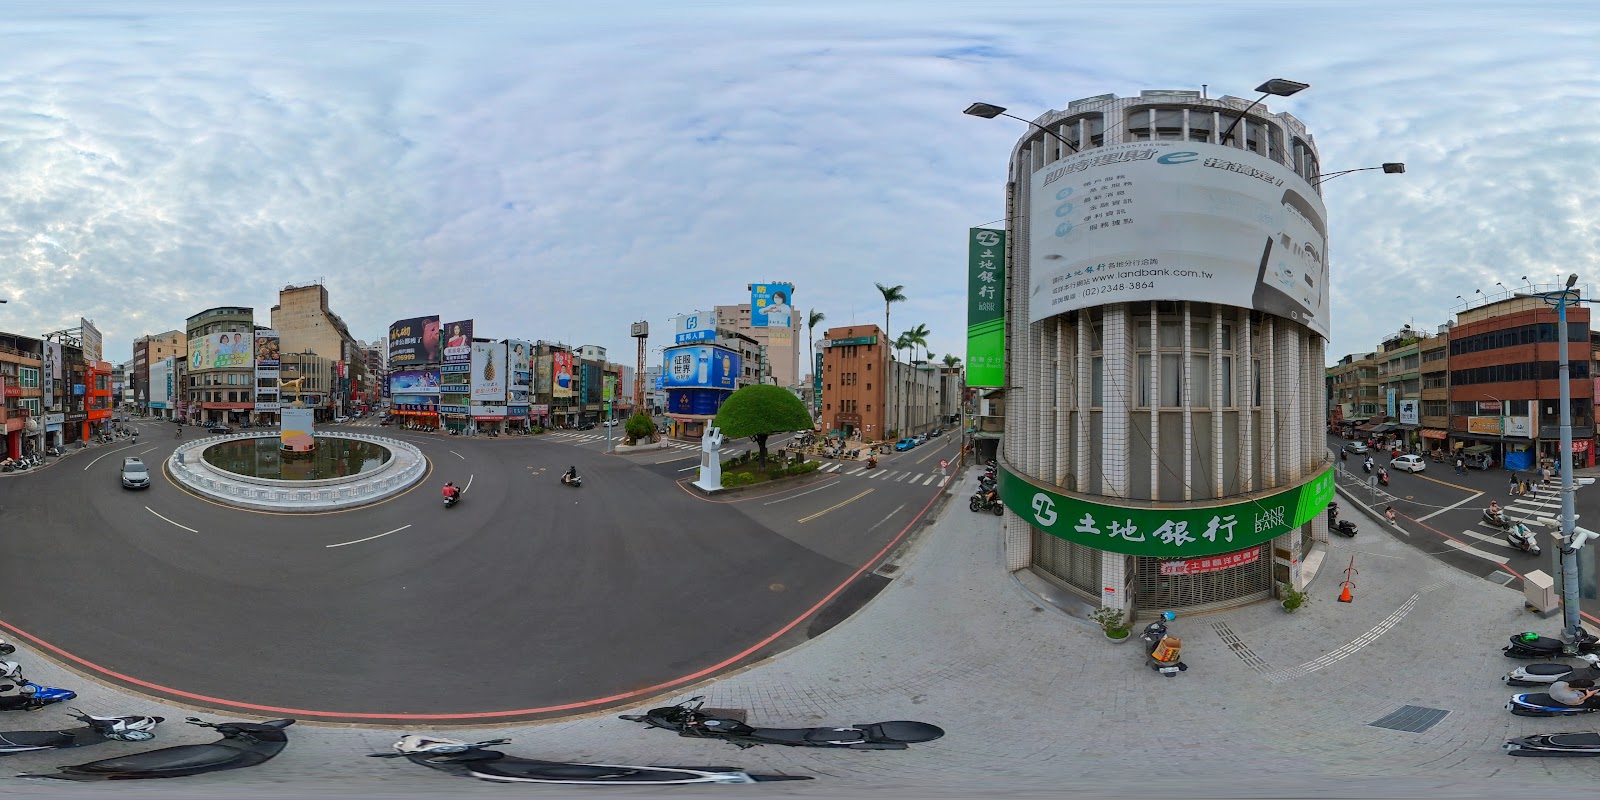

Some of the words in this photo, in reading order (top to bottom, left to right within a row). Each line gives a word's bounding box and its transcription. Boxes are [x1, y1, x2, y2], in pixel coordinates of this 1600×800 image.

[977, 248, 997, 300] 土地銀行
[1092, 268, 1214, 283] www.landbank.com.tw
[1082, 281, 1155, 299] (02)2348-3864
[674, 354, 691, 365] 征服
[674, 364, 691, 374] 世界
[1254, 505, 1285, 523] LAND
[1073, 511, 1239, 548] 土地銀行
[1254, 514, 1285, 534] BANK
